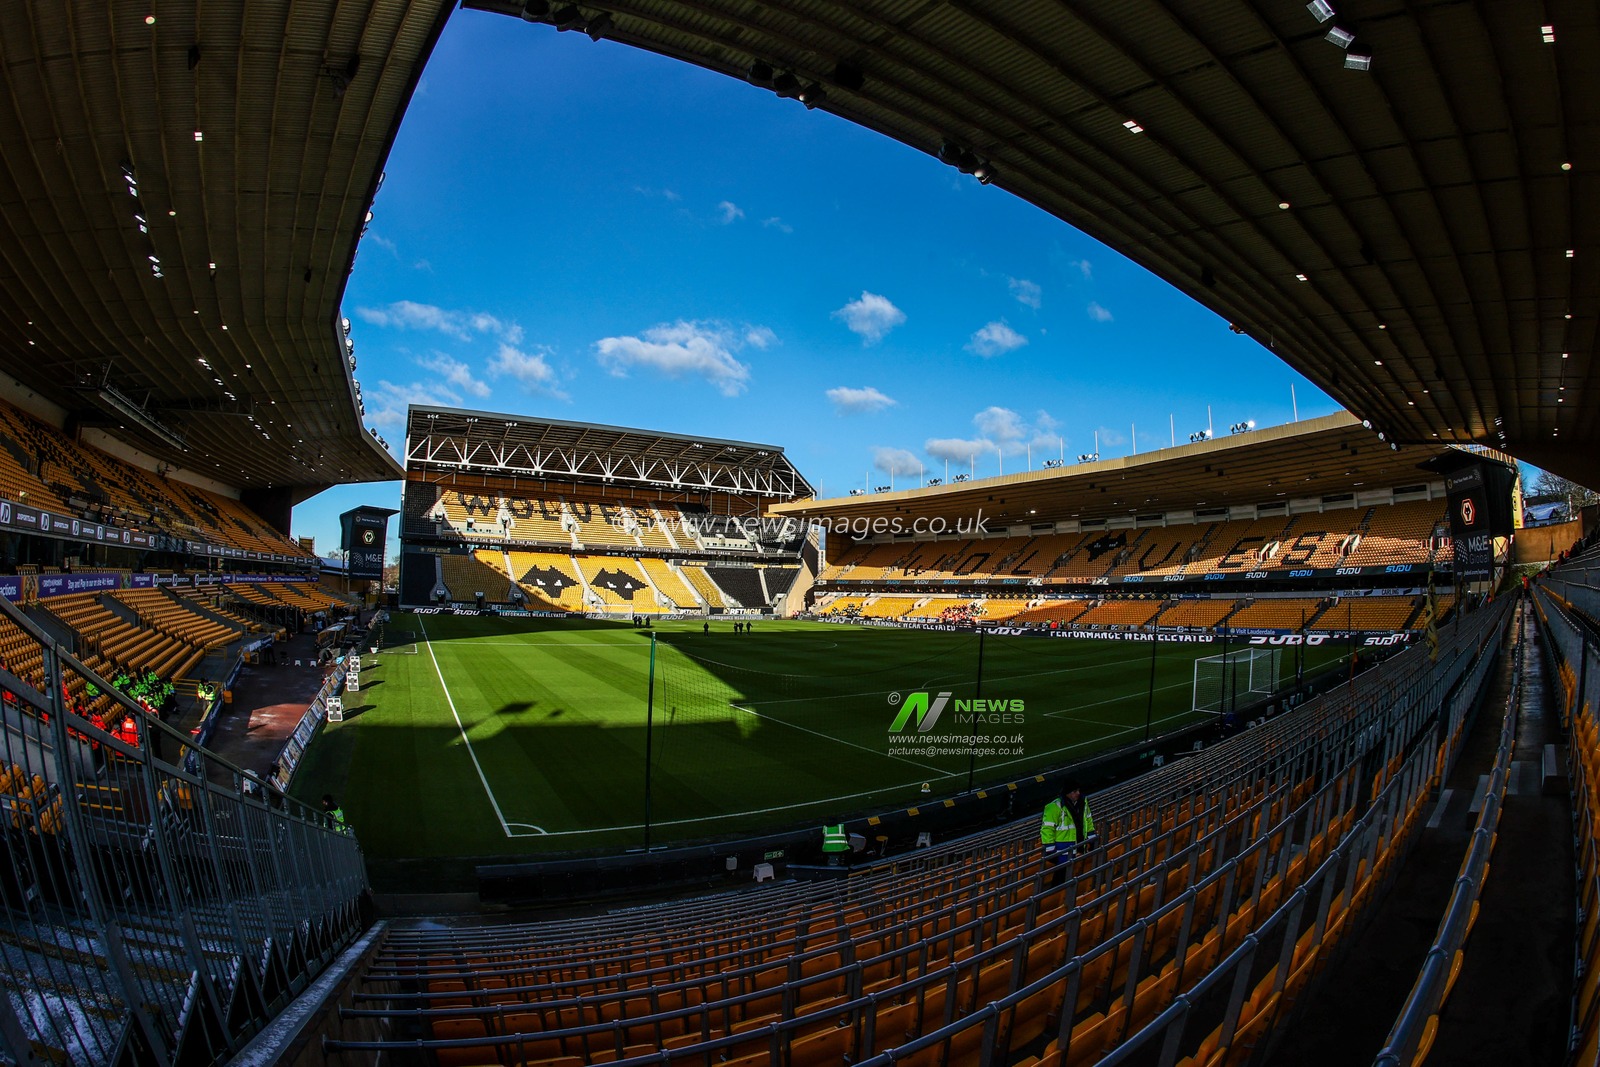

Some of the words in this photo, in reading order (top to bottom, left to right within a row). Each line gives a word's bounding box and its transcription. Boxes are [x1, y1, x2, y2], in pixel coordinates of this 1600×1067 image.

[1468, 535, 1488, 552] M&E
[366, 553, 382, 562] M&E
[1336, 567, 1361, 576] SUDU
[1385, 564, 1412, 573] SUDU
